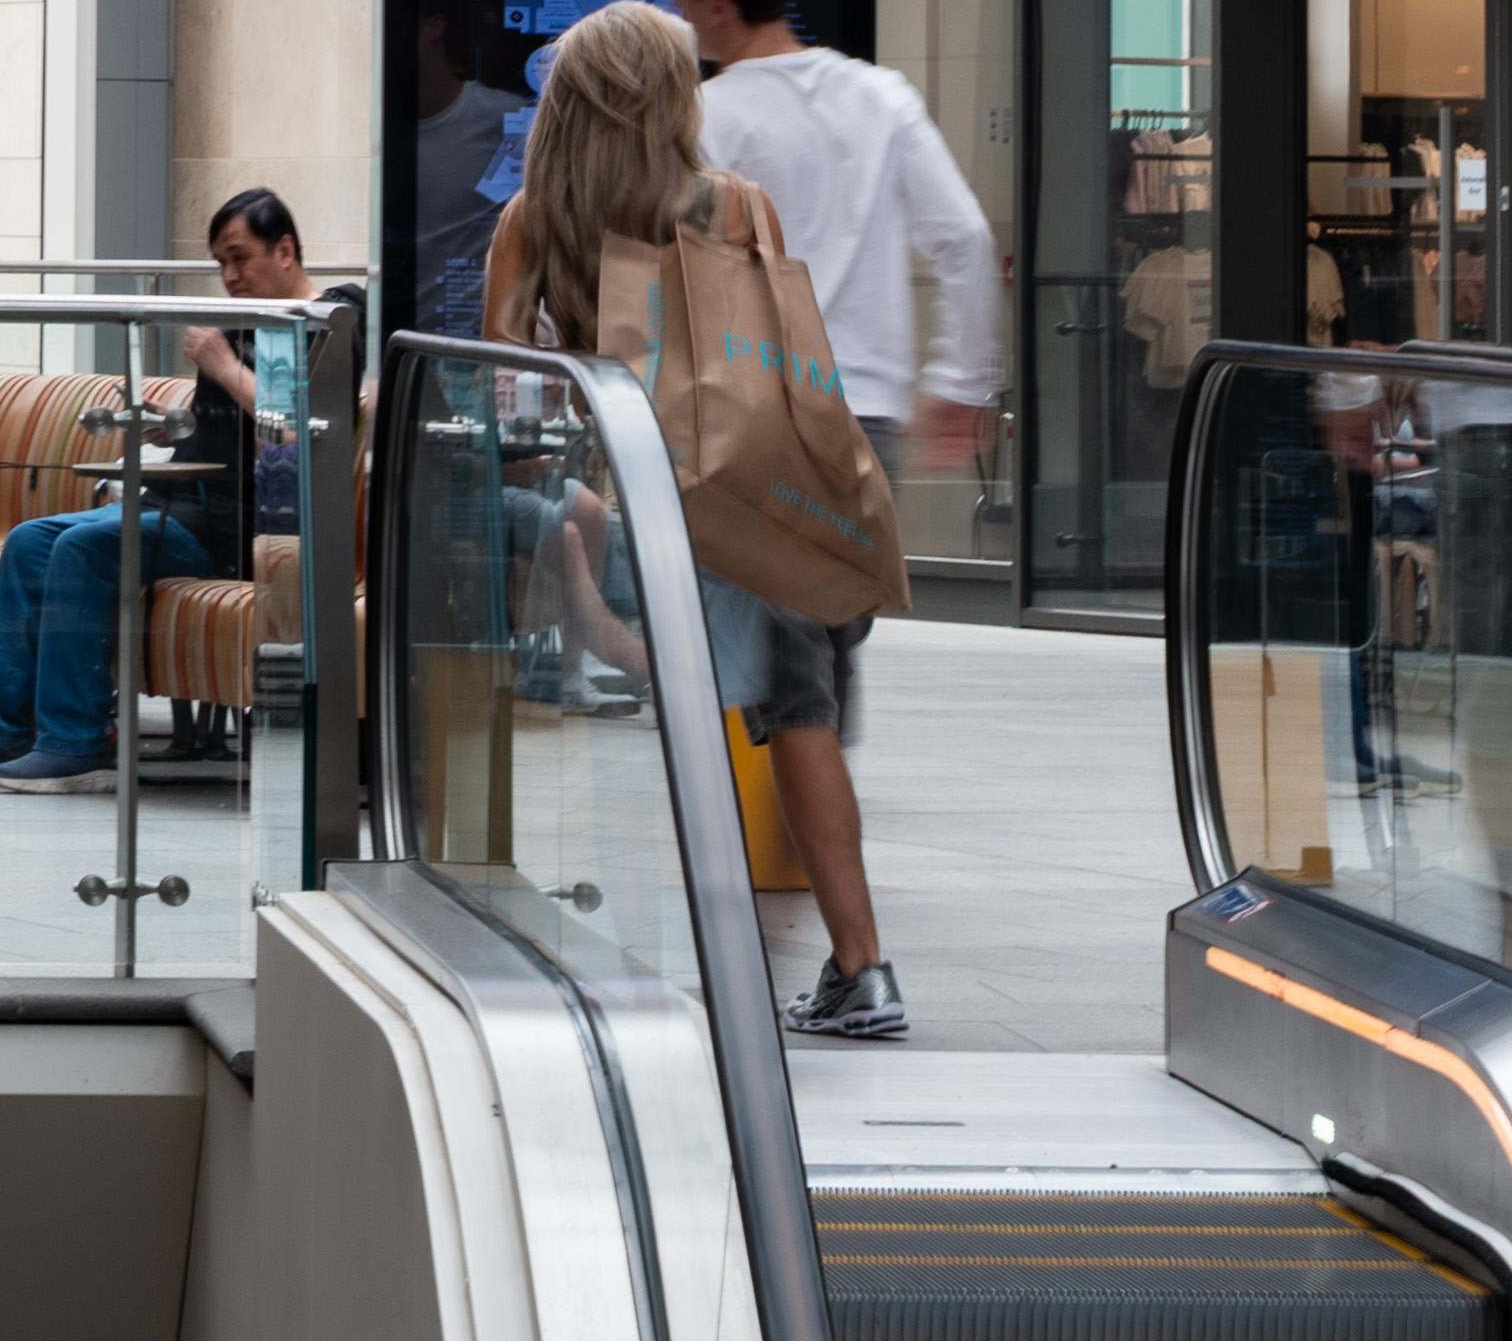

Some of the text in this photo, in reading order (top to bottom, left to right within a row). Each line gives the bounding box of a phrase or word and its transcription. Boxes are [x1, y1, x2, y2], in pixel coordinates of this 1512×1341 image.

[724, 331, 844, 398] PRIM
[769, 478, 801, 508] LOVE
[804, 496, 828, 522] THE
